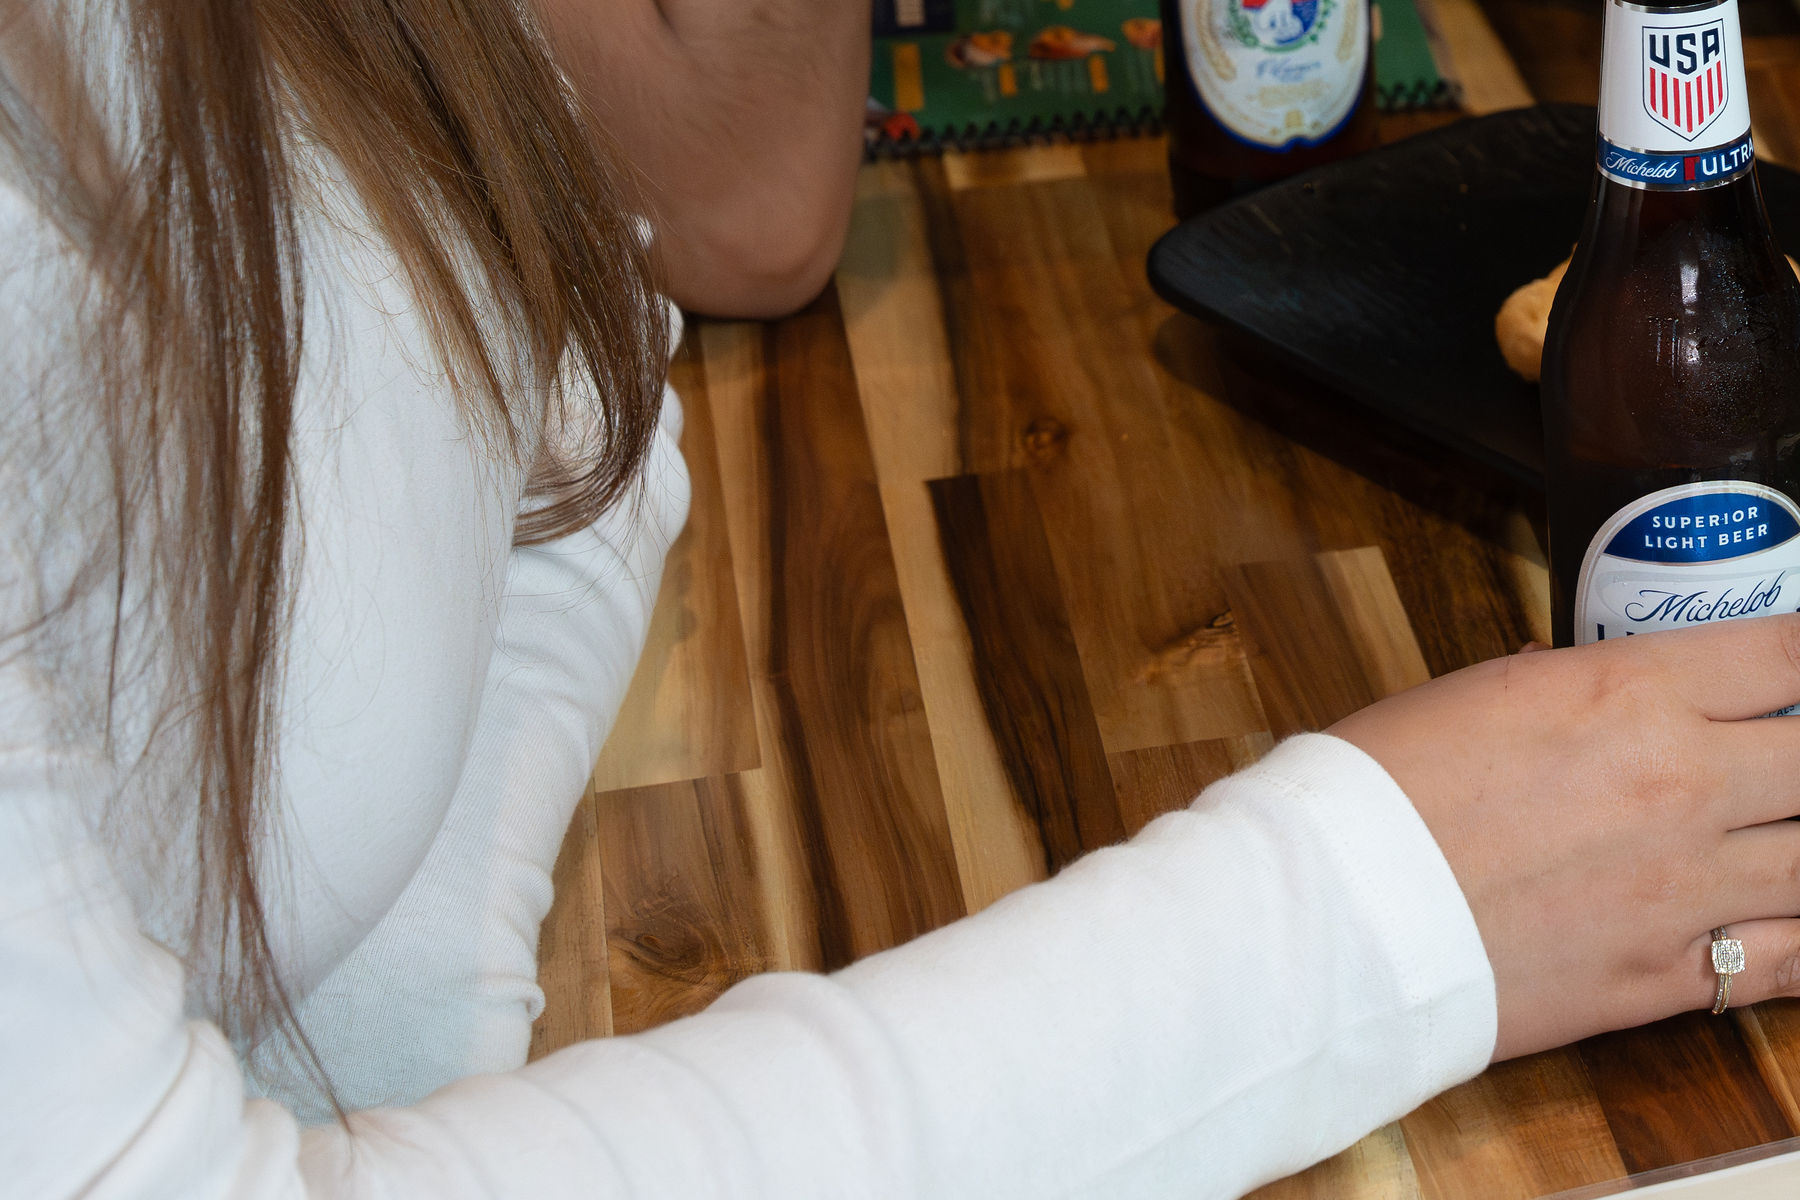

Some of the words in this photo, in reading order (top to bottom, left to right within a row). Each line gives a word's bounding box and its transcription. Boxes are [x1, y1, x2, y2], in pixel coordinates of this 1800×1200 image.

[1649, 27, 1721, 75] USA
[1605, 151, 1680, 179] Michelob
[1702, 137, 1754, 176] ULTRA
[1644, 535, 1707, 549] LIGHT
[1718, 523, 1768, 547] BEER
[1652, 506, 1759, 529] SUPERIOR
[1624, 570, 1786, 622] Michelob
